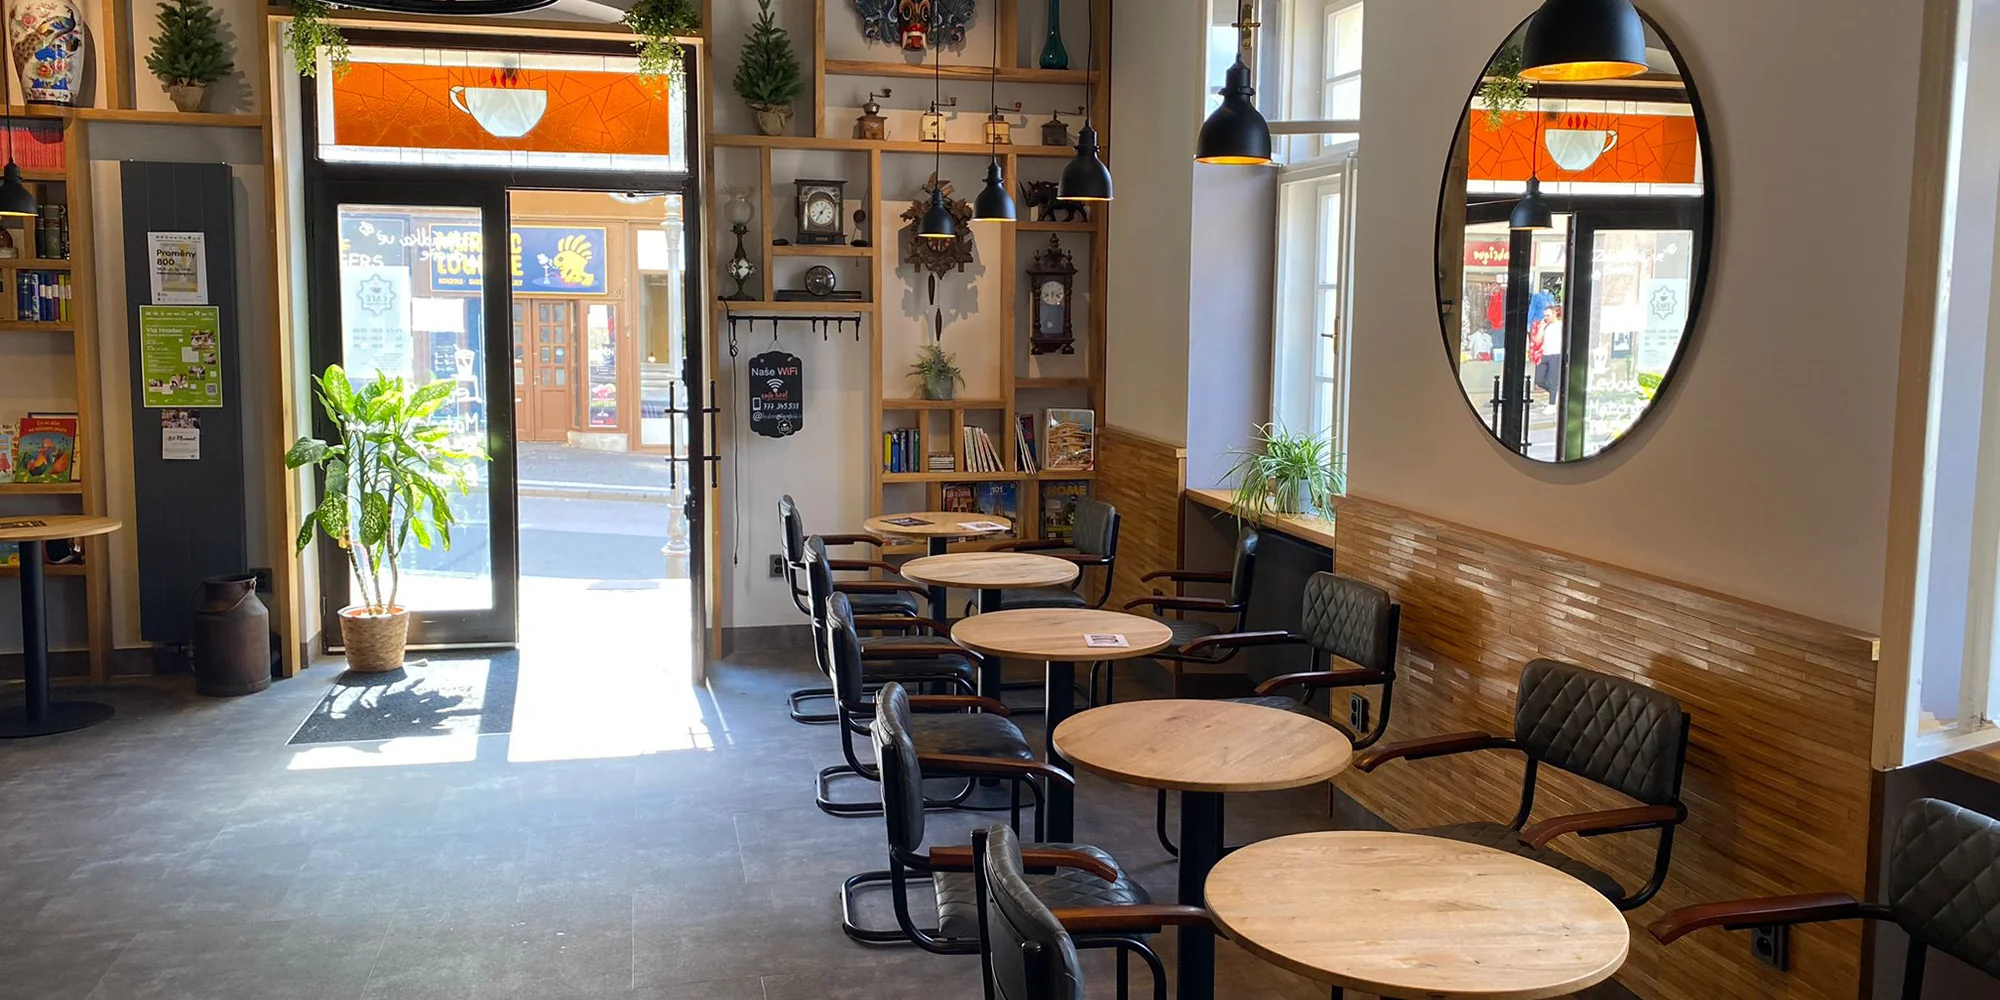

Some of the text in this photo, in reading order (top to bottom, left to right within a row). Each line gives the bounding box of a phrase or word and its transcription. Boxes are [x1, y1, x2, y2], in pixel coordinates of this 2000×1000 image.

[156, 249, 197, 259] Proměny
[751, 367, 775, 377] Naše
[991, 486, 1003, 495] 101
[1046, 485, 1087, 496] HOME
